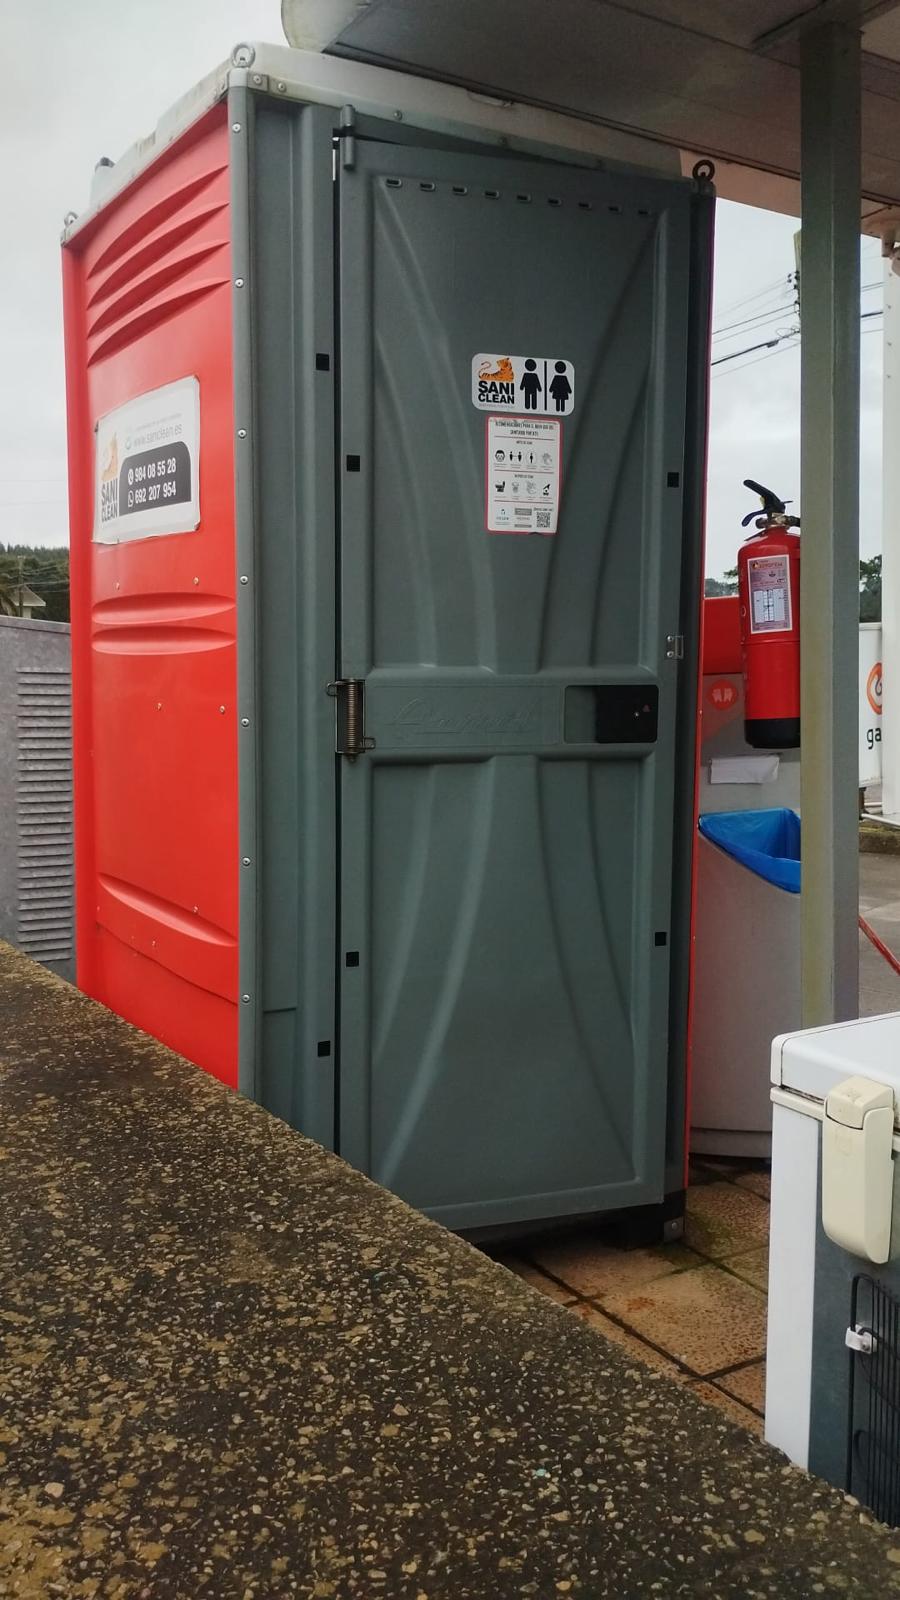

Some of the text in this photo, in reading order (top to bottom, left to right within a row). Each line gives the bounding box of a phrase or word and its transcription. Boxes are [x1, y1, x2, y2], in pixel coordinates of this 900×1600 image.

[478, 380, 515, 395] SANI
[478, 393, 515, 404] CLEAN
[135, 457, 177, 483] 984 08 55 28
[101, 478, 119, 506] SANI
[135, 481, 177, 504] 692 207 954
[101, 501, 118, 523] CLEAN
